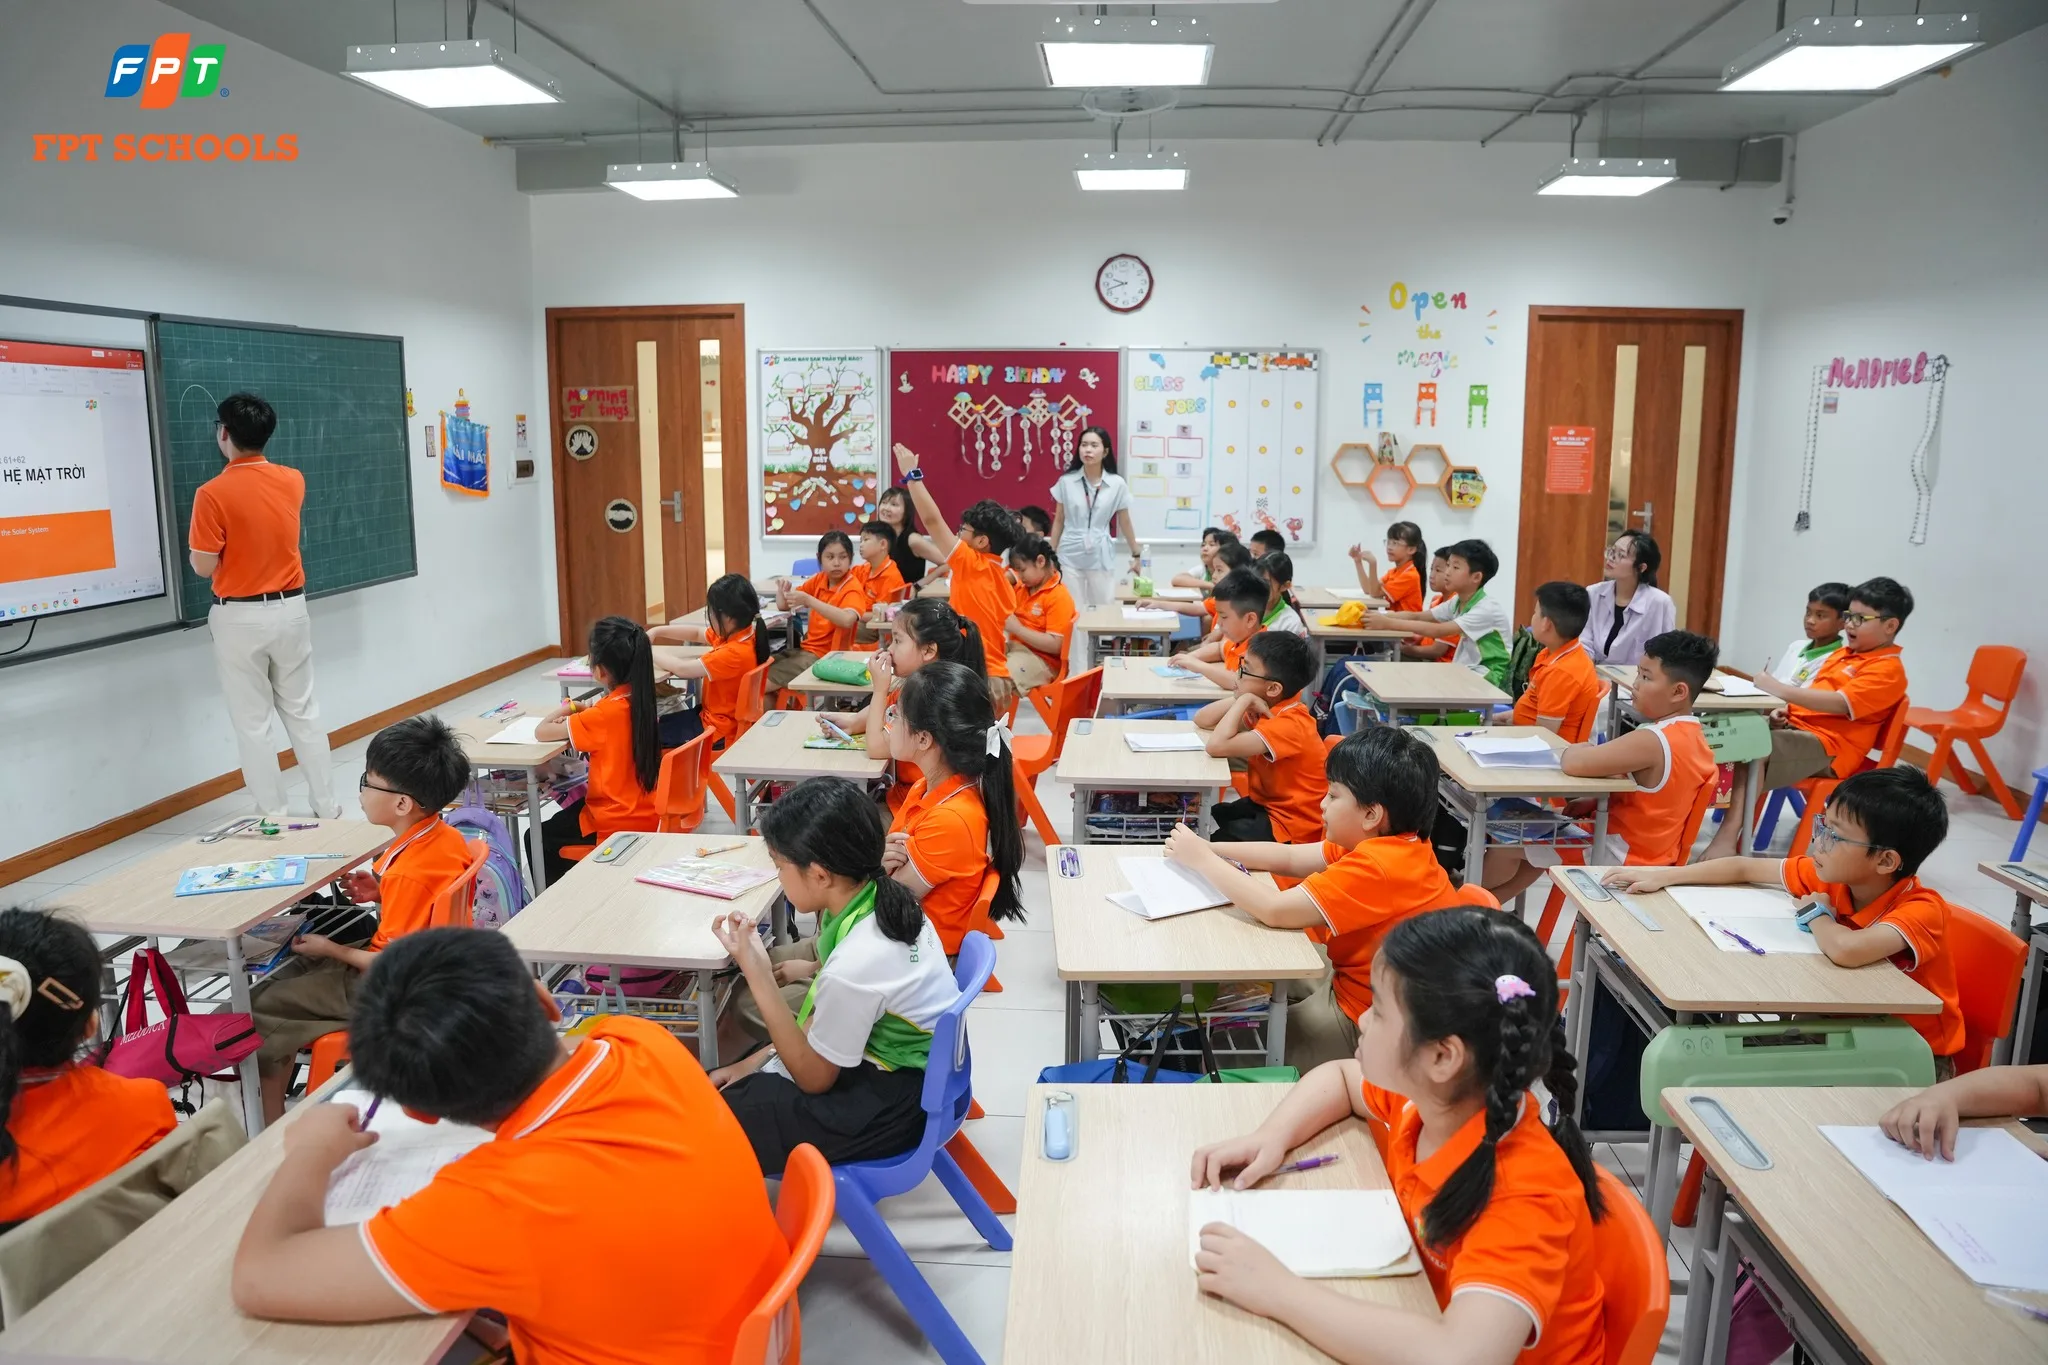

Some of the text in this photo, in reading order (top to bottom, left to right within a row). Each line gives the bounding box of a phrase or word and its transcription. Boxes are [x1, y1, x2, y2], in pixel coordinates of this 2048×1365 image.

[1389, 281, 1467, 321] Open
[1416, 323, 1441, 339] the
[932, 364, 1067, 385] HAPPY BIRTHDAY
[1134, 375, 1185, 392] CLASS
[567, 388, 628, 405] Mrning
[1165, 397, 1206, 415] JOBS
[3, 456, 26, 464] 61+62
[3, 466, 22, 485] HỆ
[56, 464, 86, 480] TRỜI
[12, 528, 27, 536] Solar
[28, 526, 49, 535] System
